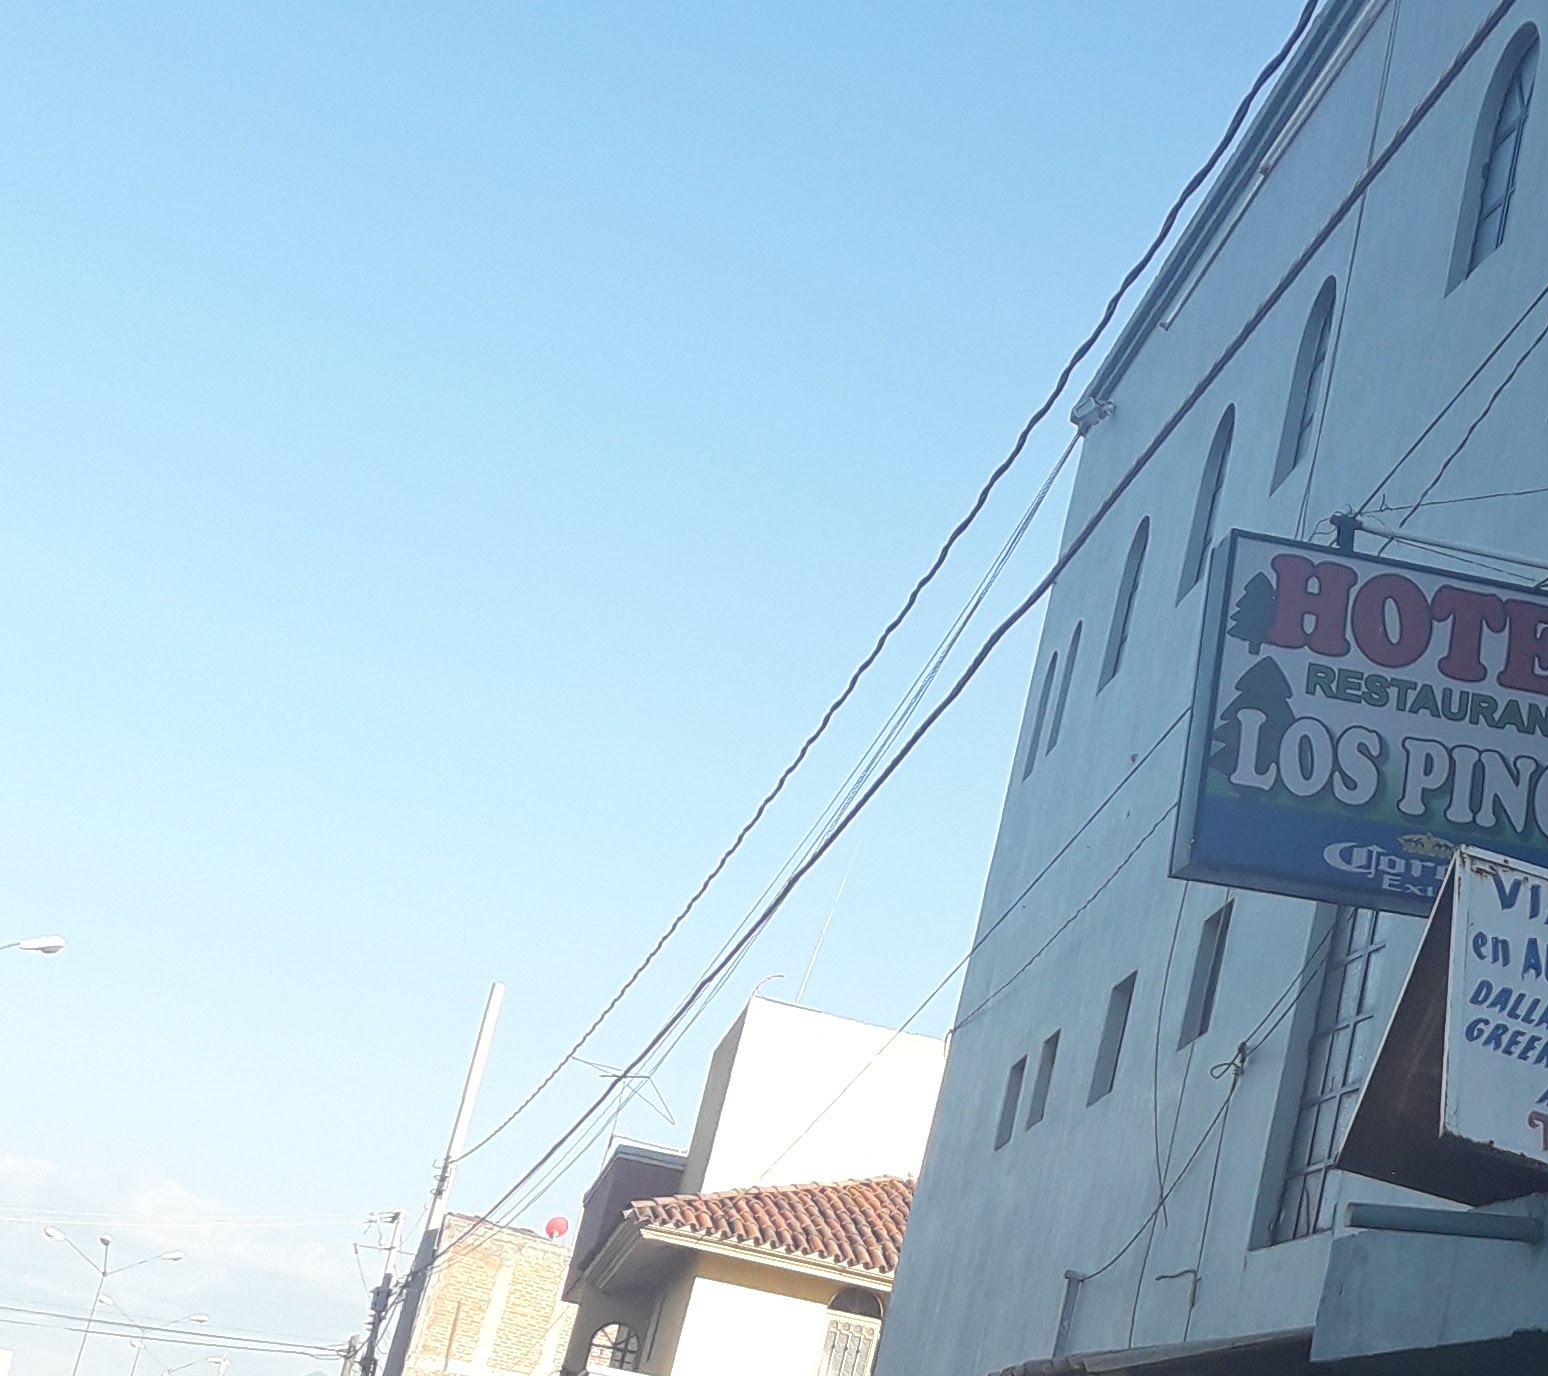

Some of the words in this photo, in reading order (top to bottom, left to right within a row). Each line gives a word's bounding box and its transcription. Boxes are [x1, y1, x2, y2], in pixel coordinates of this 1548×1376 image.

[1230, 708, 1383, 806] LOS
[1323, 841, 1448, 881] Cor
[1471, 930, 1512, 969] en
